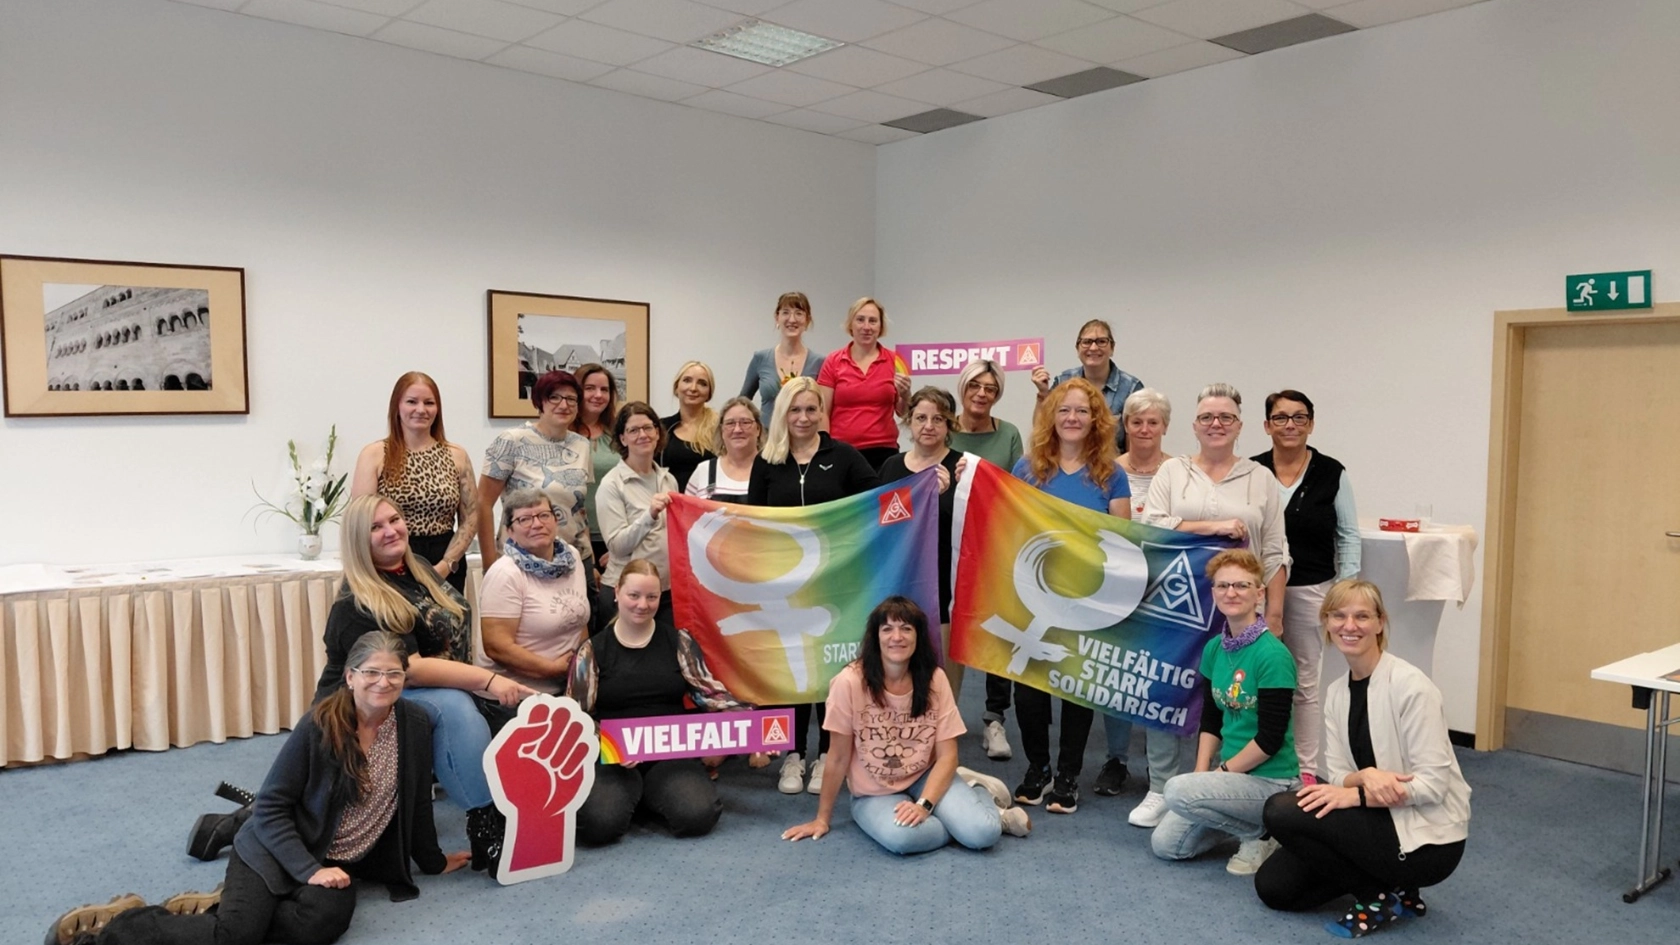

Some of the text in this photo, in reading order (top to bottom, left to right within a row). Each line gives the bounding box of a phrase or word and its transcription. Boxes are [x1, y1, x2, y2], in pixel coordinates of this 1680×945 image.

[911, 346, 1010, 370] RESPEKT
[823, 641, 861, 664] STAR
[1078, 634, 1196, 689] VIELFÄLTIG
[1048, 669, 1188, 727] SOLIDARISCH
[1080, 659, 1153, 699] STARK
[621, 719, 752, 756] VIELFALT
